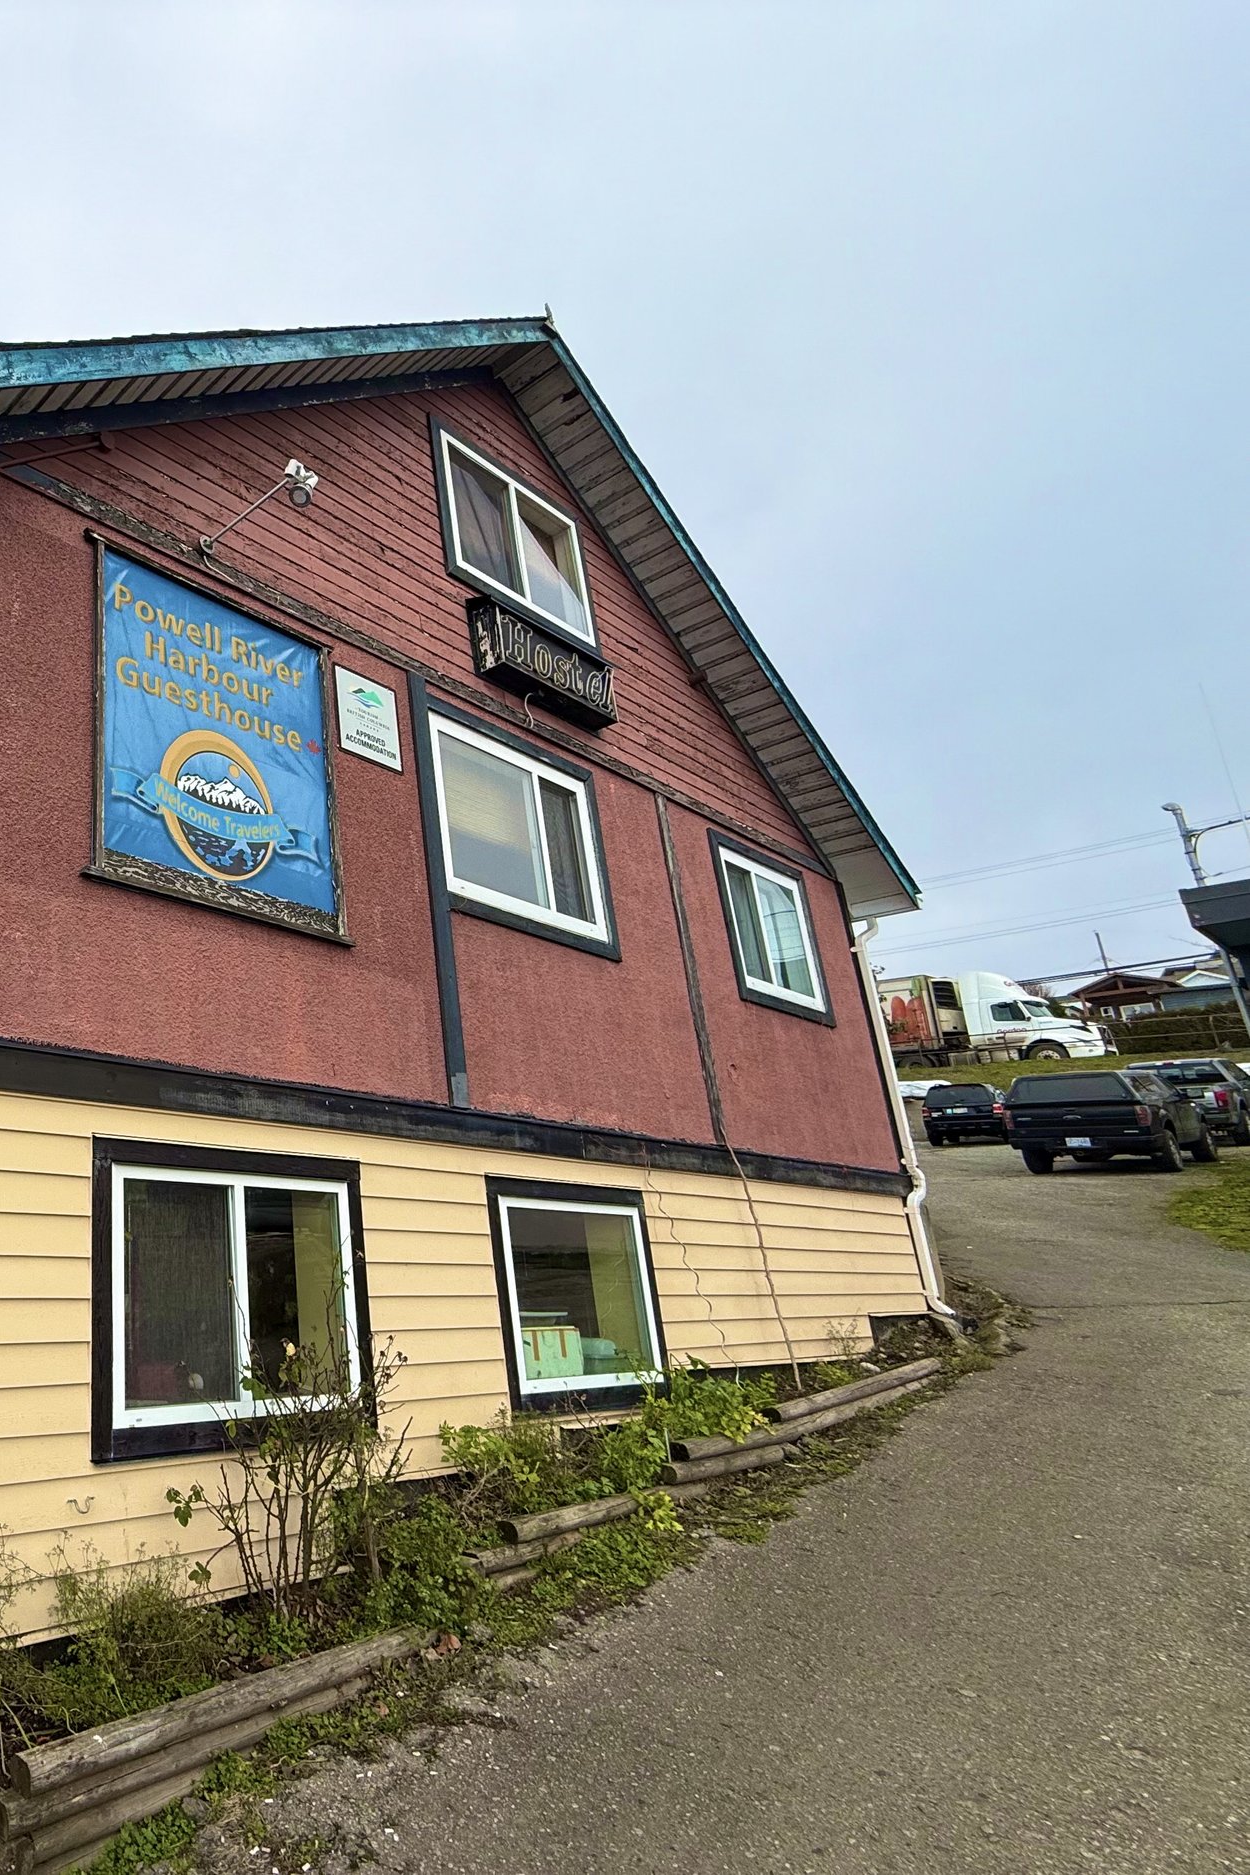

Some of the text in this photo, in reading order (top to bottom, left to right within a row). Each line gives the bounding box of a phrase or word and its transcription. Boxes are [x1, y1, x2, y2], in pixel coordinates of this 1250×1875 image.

[114, 583, 303, 688] Powell River
[145, 631, 274, 706] Harbour
[501, 615, 614, 713] Hostel
[116, 656, 303, 752] Guesthouse
[356, 729, 386, 747] APPROVED
[345, 733, 397, 760] ACCOMMODATION
[155, 779, 281, 839] Welcome Travelers
